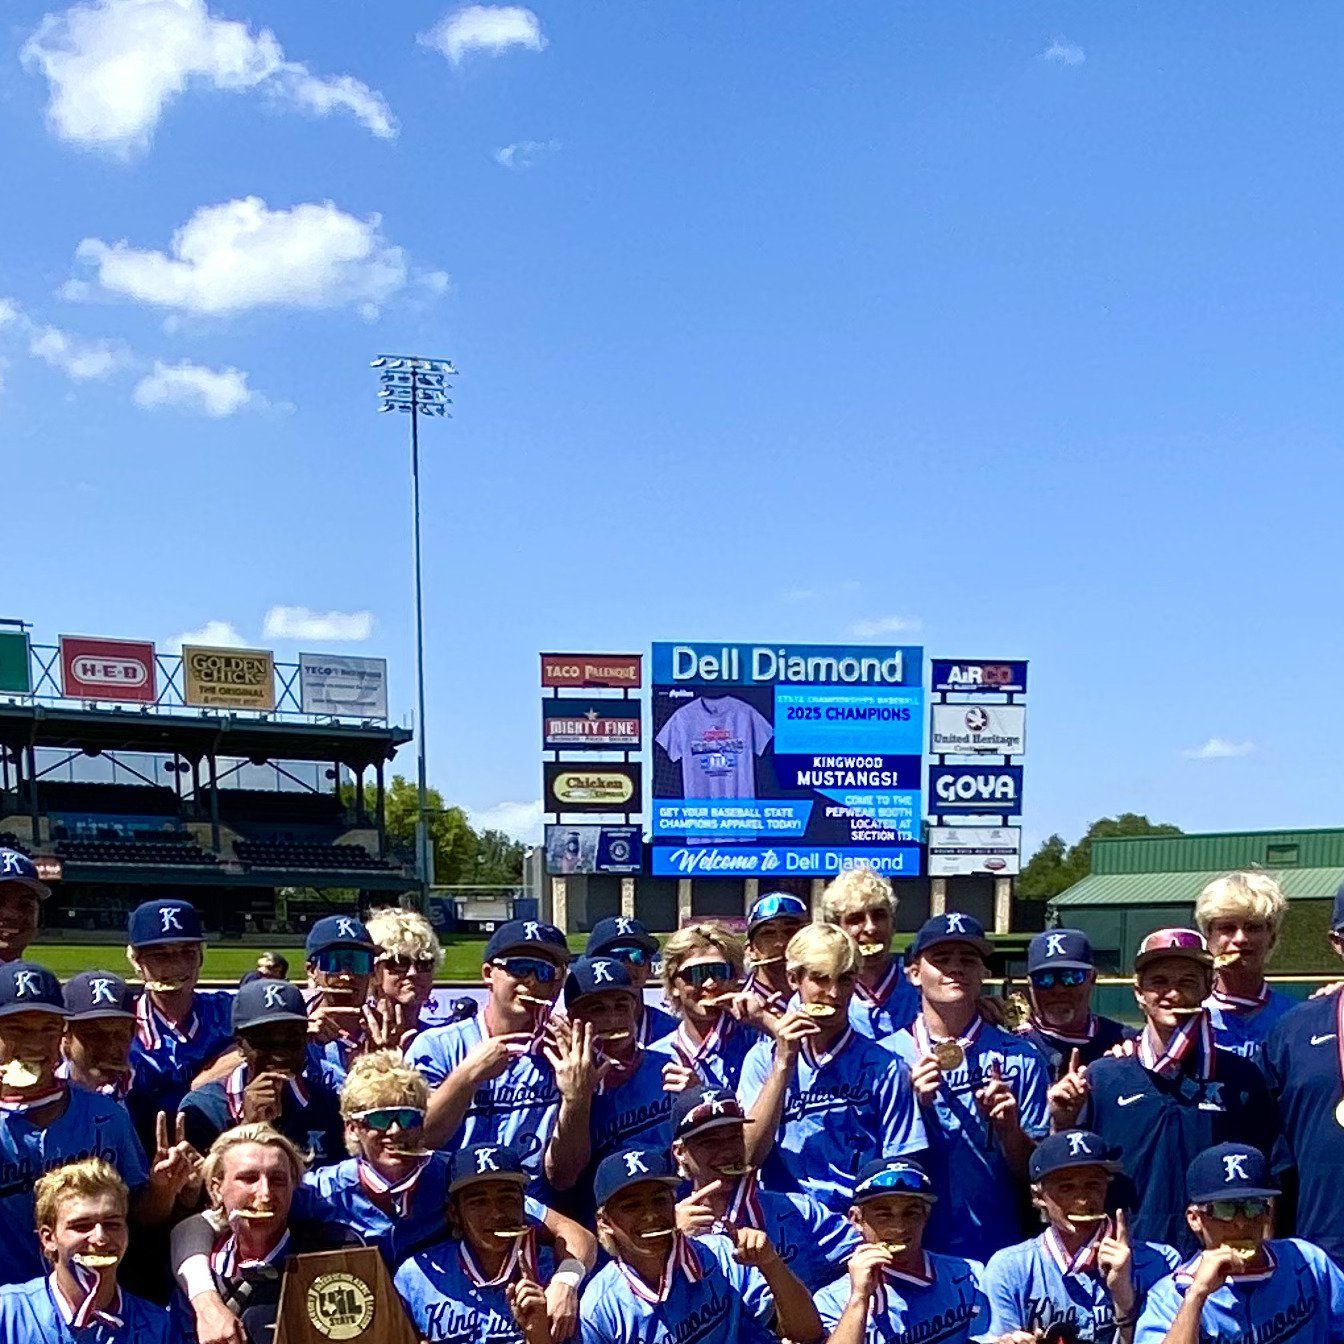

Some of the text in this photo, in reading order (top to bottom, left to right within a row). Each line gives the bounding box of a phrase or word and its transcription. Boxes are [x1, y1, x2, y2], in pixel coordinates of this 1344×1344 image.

[193, 654, 266, 673] GOLDEN
[672, 646, 903, 683] Dell Diamond
[201, 671, 257, 684] CHICK
[546, 666, 580, 677] TACO
[199, 685, 264, 698] THE ORIGINAL
[787, 707, 911, 721] 2025 CHAMPIONS
[550, 721, 634, 735] MIGHTY FINE
[934, 734, 1020, 746] United Heritage
[813, 757, 883, 768] KINGWOOD
[566, 777, 623, 789] Chicken
[797, 771, 898, 786] MUSTANGS!
[936, 775, 1014, 801] GOYA
[845, 796, 912, 805] COME TO THE
[659, 808, 794, 818] GET YOUR BASEBALL STATE
[825, 807, 912, 818] PEPWEAR BOOTH
[659, 819, 801, 830] CHAMPIONS APPAREL TODAY!
[850, 819, 912, 830] LOCATED AT
[851, 831, 895, 841] SECTION
[670, 850, 903, 873] Welcome to Dell Diamond
